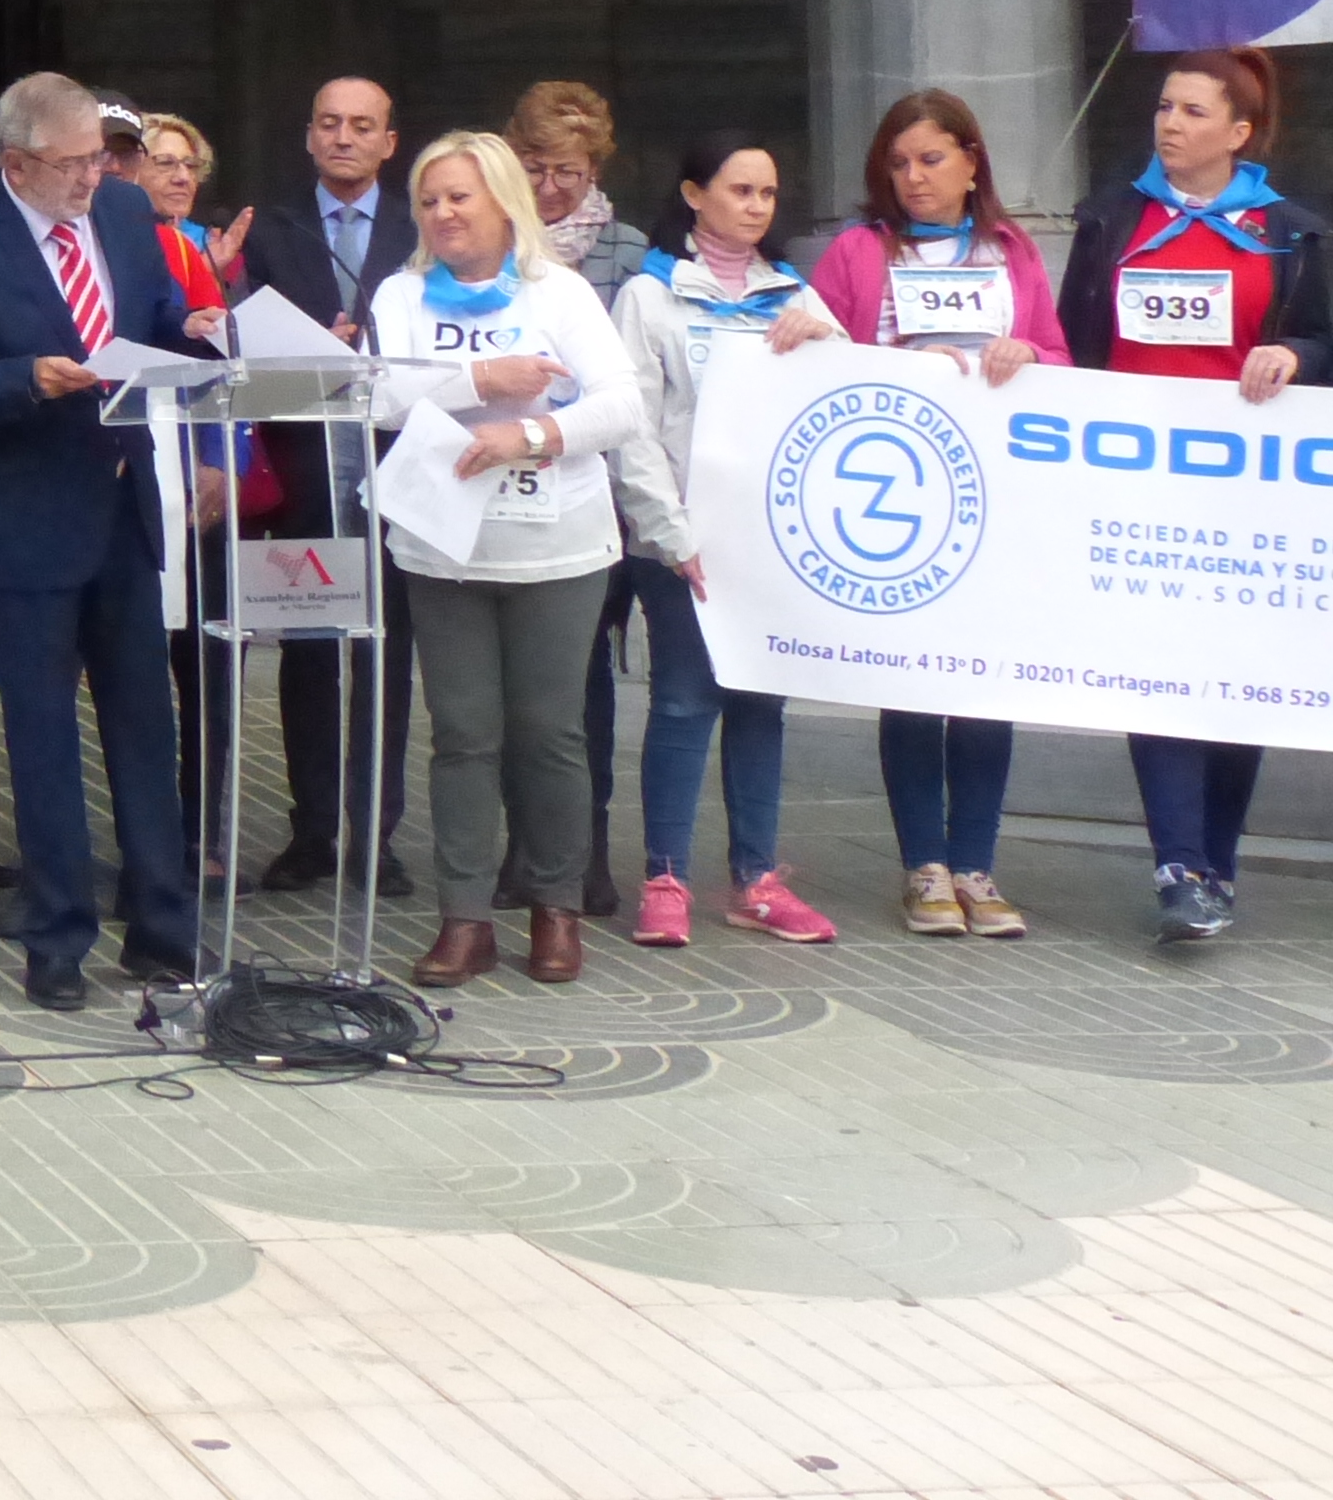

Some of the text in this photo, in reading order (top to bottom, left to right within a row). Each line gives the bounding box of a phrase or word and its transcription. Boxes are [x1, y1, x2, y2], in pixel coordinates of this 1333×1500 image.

[921, 290, 982, 311] 941
[1144, 295, 1210, 320] 939
[775, 391, 978, 526] SOCIEDAD DE DIABETES
[1090, 518, 1228, 547] SOCIEDAD
[1253, 533, 1287, 552] DE
[798, 549, 950, 607] CARTAGENA
[1090, 546, 1324, 582] DE CARTAGENA Y SU
[766, 634, 834, 660] Tolosa
[840, 645, 912, 671] Latour,
[917, 654, 929, 670] 4
[972, 658, 986, 676] D
[1013, 662, 1074, 685] 30201
[1082, 669, 1191, 697] Cartagena
[1218, 682, 1236, 700] T.
[1242, 685, 1283, 704] 968
[1289, 689, 1330, 708] 529
